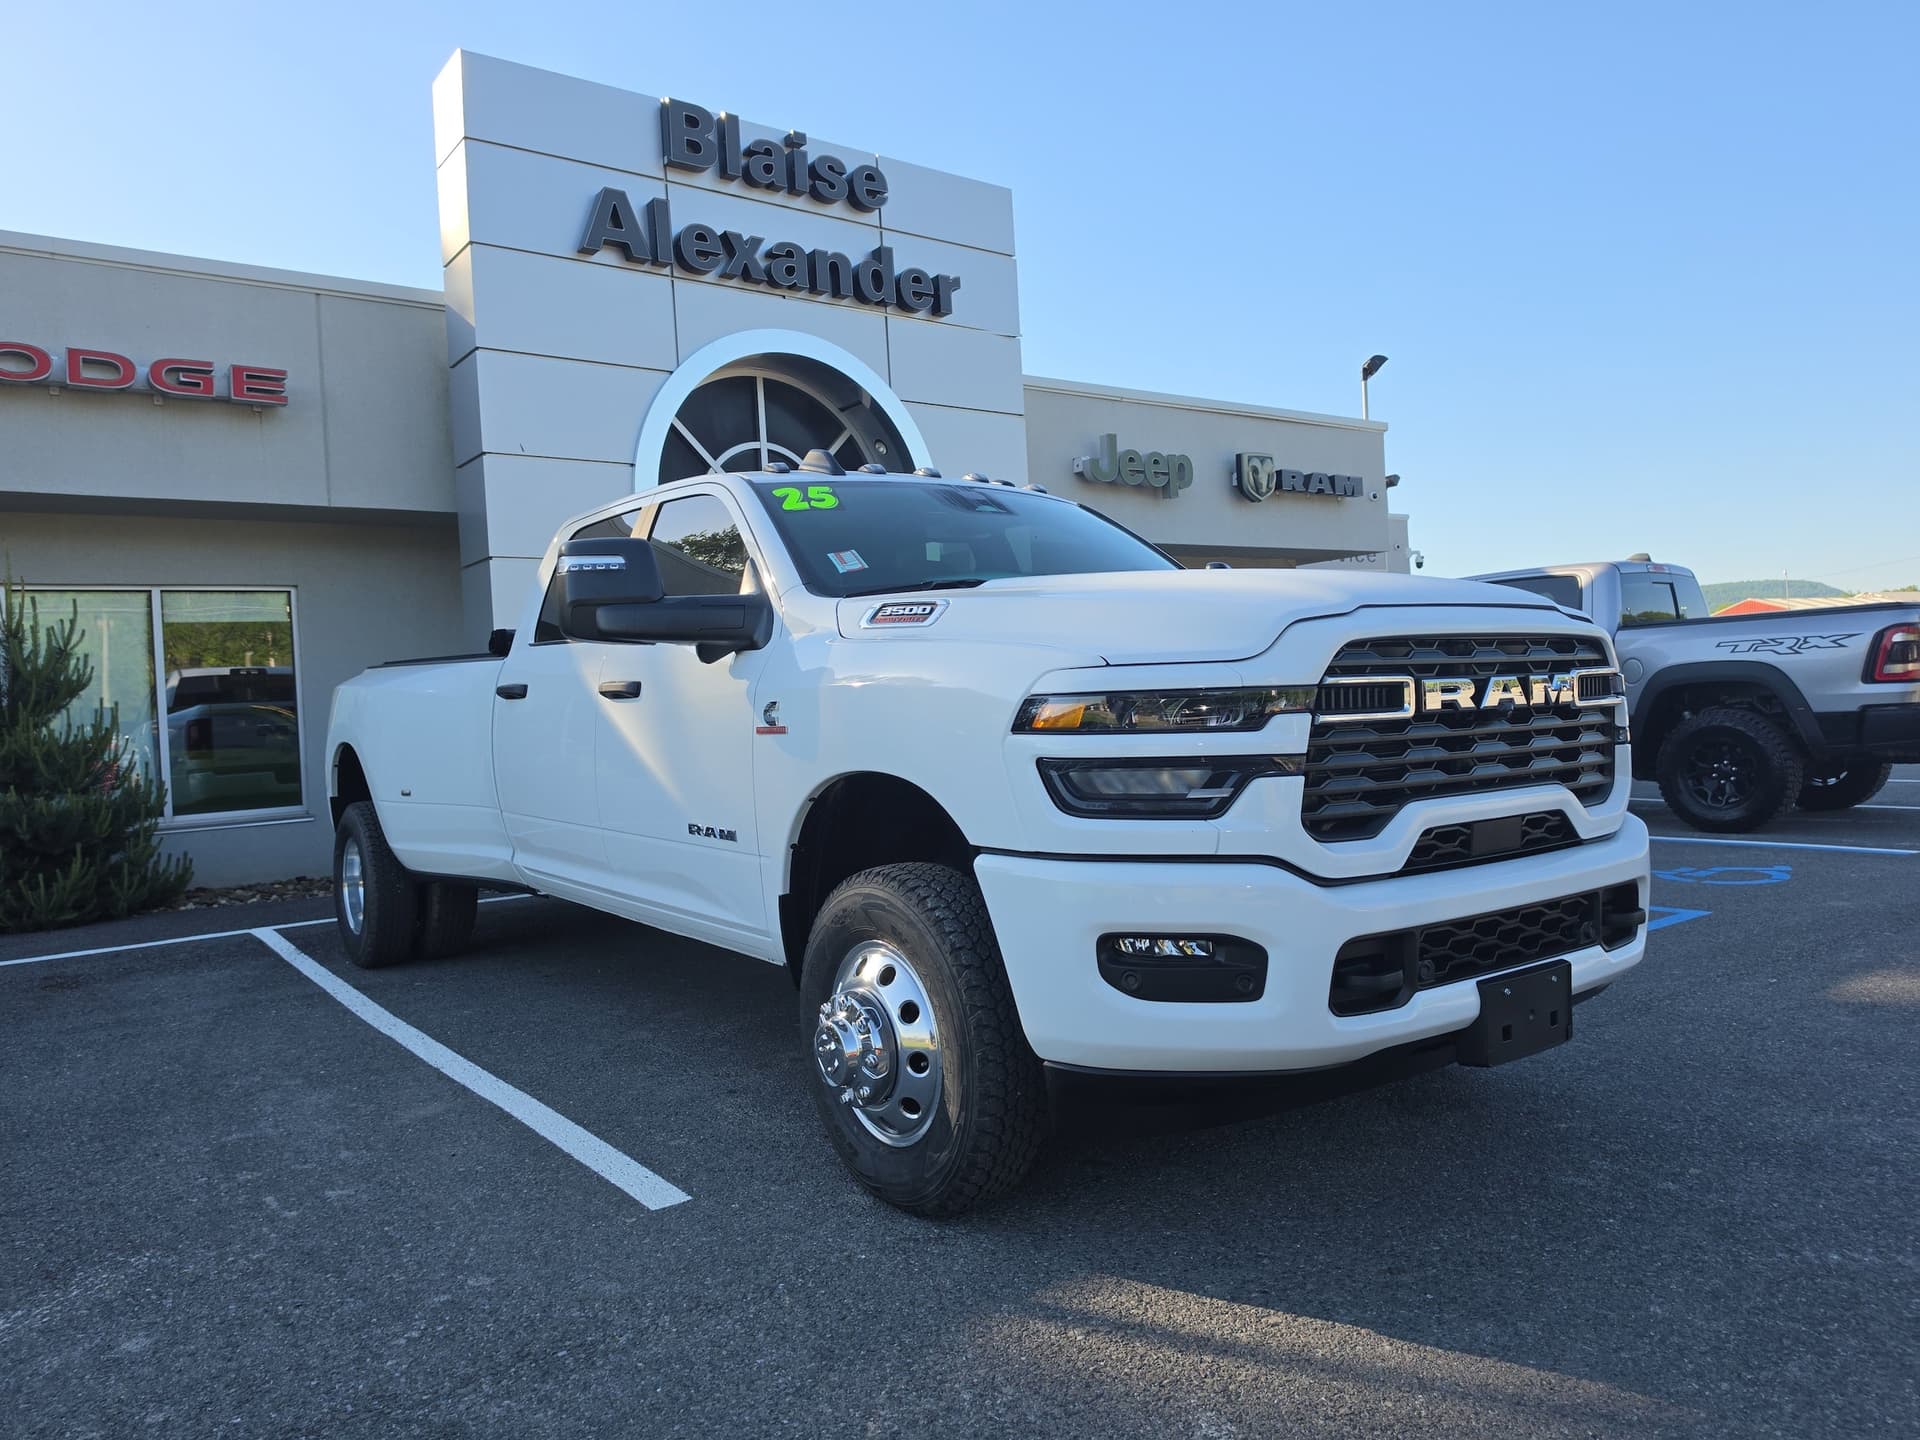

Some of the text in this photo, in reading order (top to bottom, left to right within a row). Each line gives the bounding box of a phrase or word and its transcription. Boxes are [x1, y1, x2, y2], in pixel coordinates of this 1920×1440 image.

[661, 97, 888, 213] Blaise
[578, 186, 961, 317] Alexander
[1082, 433, 1193, 499] Jeep
[1276, 468, 1363, 497] RAM
[772, 486, 839, 511] 25
[879, 605, 932, 616] 3500
[1715, 633, 1864, 655] TRX
[1422, 674, 1575, 711] RAM
[688, 823, 737, 842] RAM
